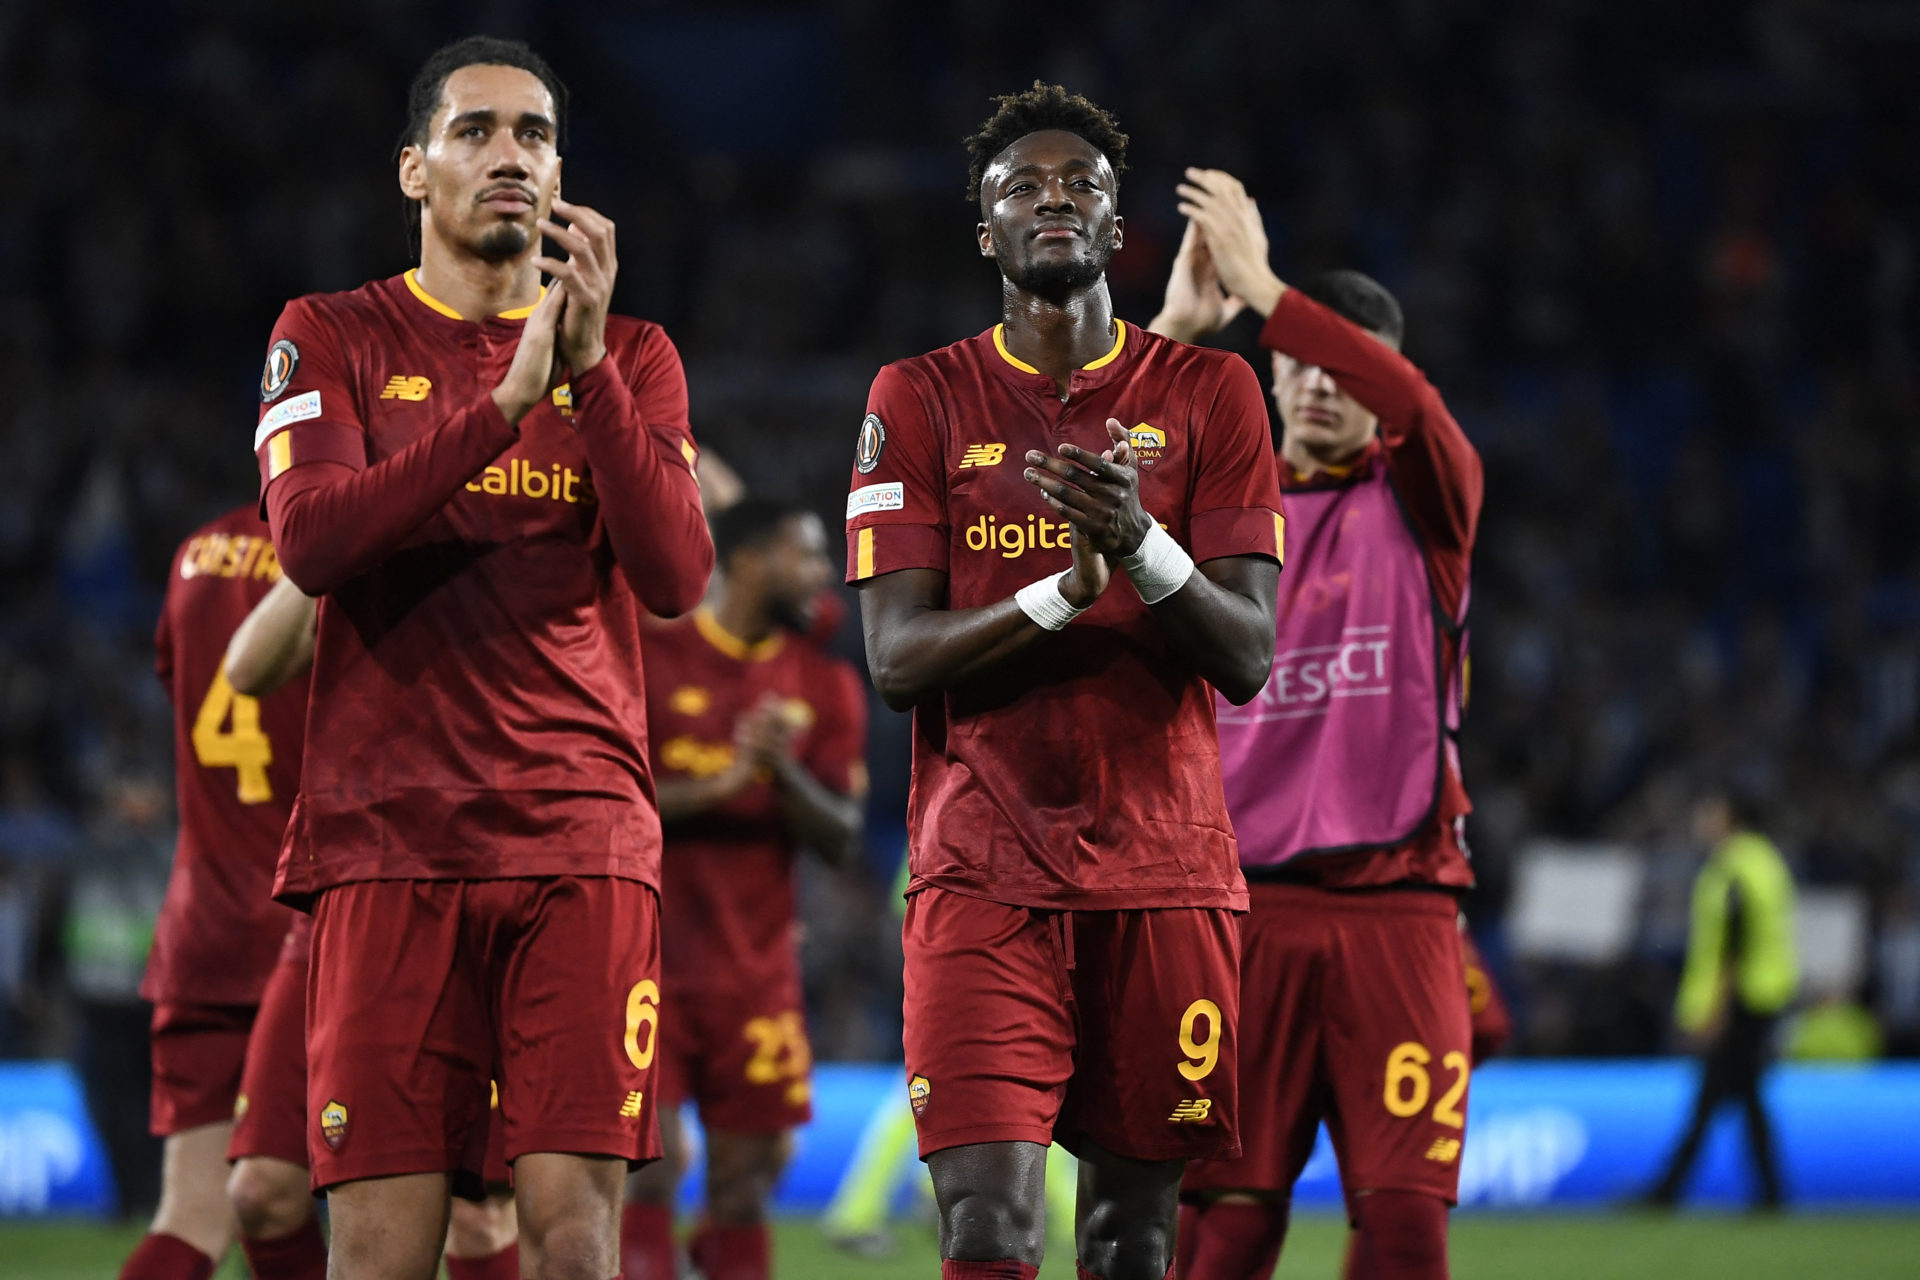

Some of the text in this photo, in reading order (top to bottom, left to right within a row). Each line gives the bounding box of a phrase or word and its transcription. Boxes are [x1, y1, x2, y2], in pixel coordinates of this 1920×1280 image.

[465, 458, 598, 505] albits
[192, 655, 274, 805] 4
[623, 979, 661, 1070] 6
[1176, 998, 1222, 1081] 9
[1383, 1041, 1470, 1129] 62
